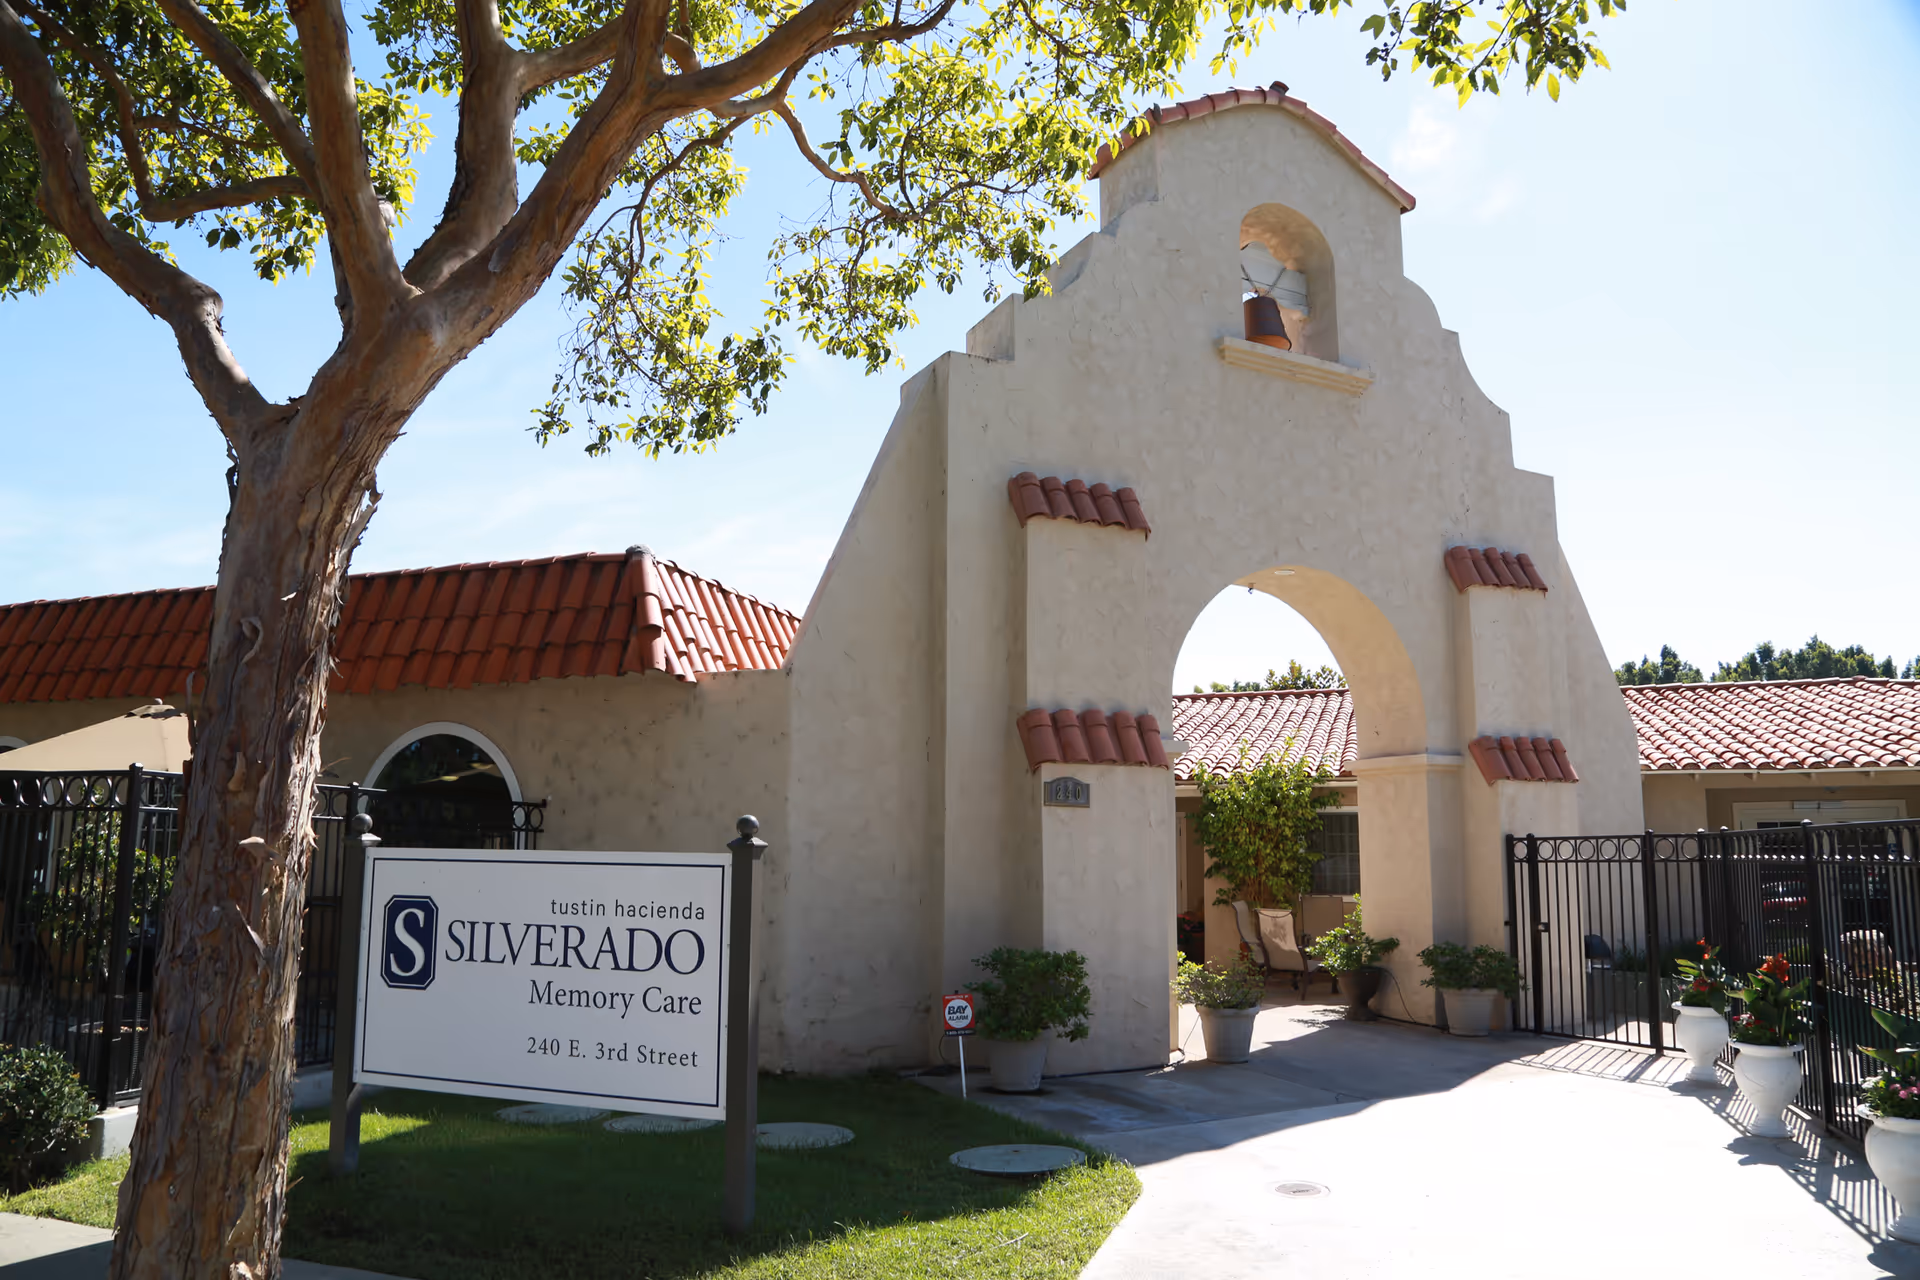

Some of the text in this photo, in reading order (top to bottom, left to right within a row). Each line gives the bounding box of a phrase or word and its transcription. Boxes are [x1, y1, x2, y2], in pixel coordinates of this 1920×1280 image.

[1056, 784, 1081, 801] 240
[550, 898, 705, 921] tustin hacienda
[390, 907, 425, 977] S
[444, 919, 706, 976] SILVERADO
[527, 979, 702, 1020] Memory Care
[947, 1004, 968, 1016] BAY
[947, 1014, 969, 1022] ALARM
[526, 1036, 698, 1068] 240 E. 3rd Street
